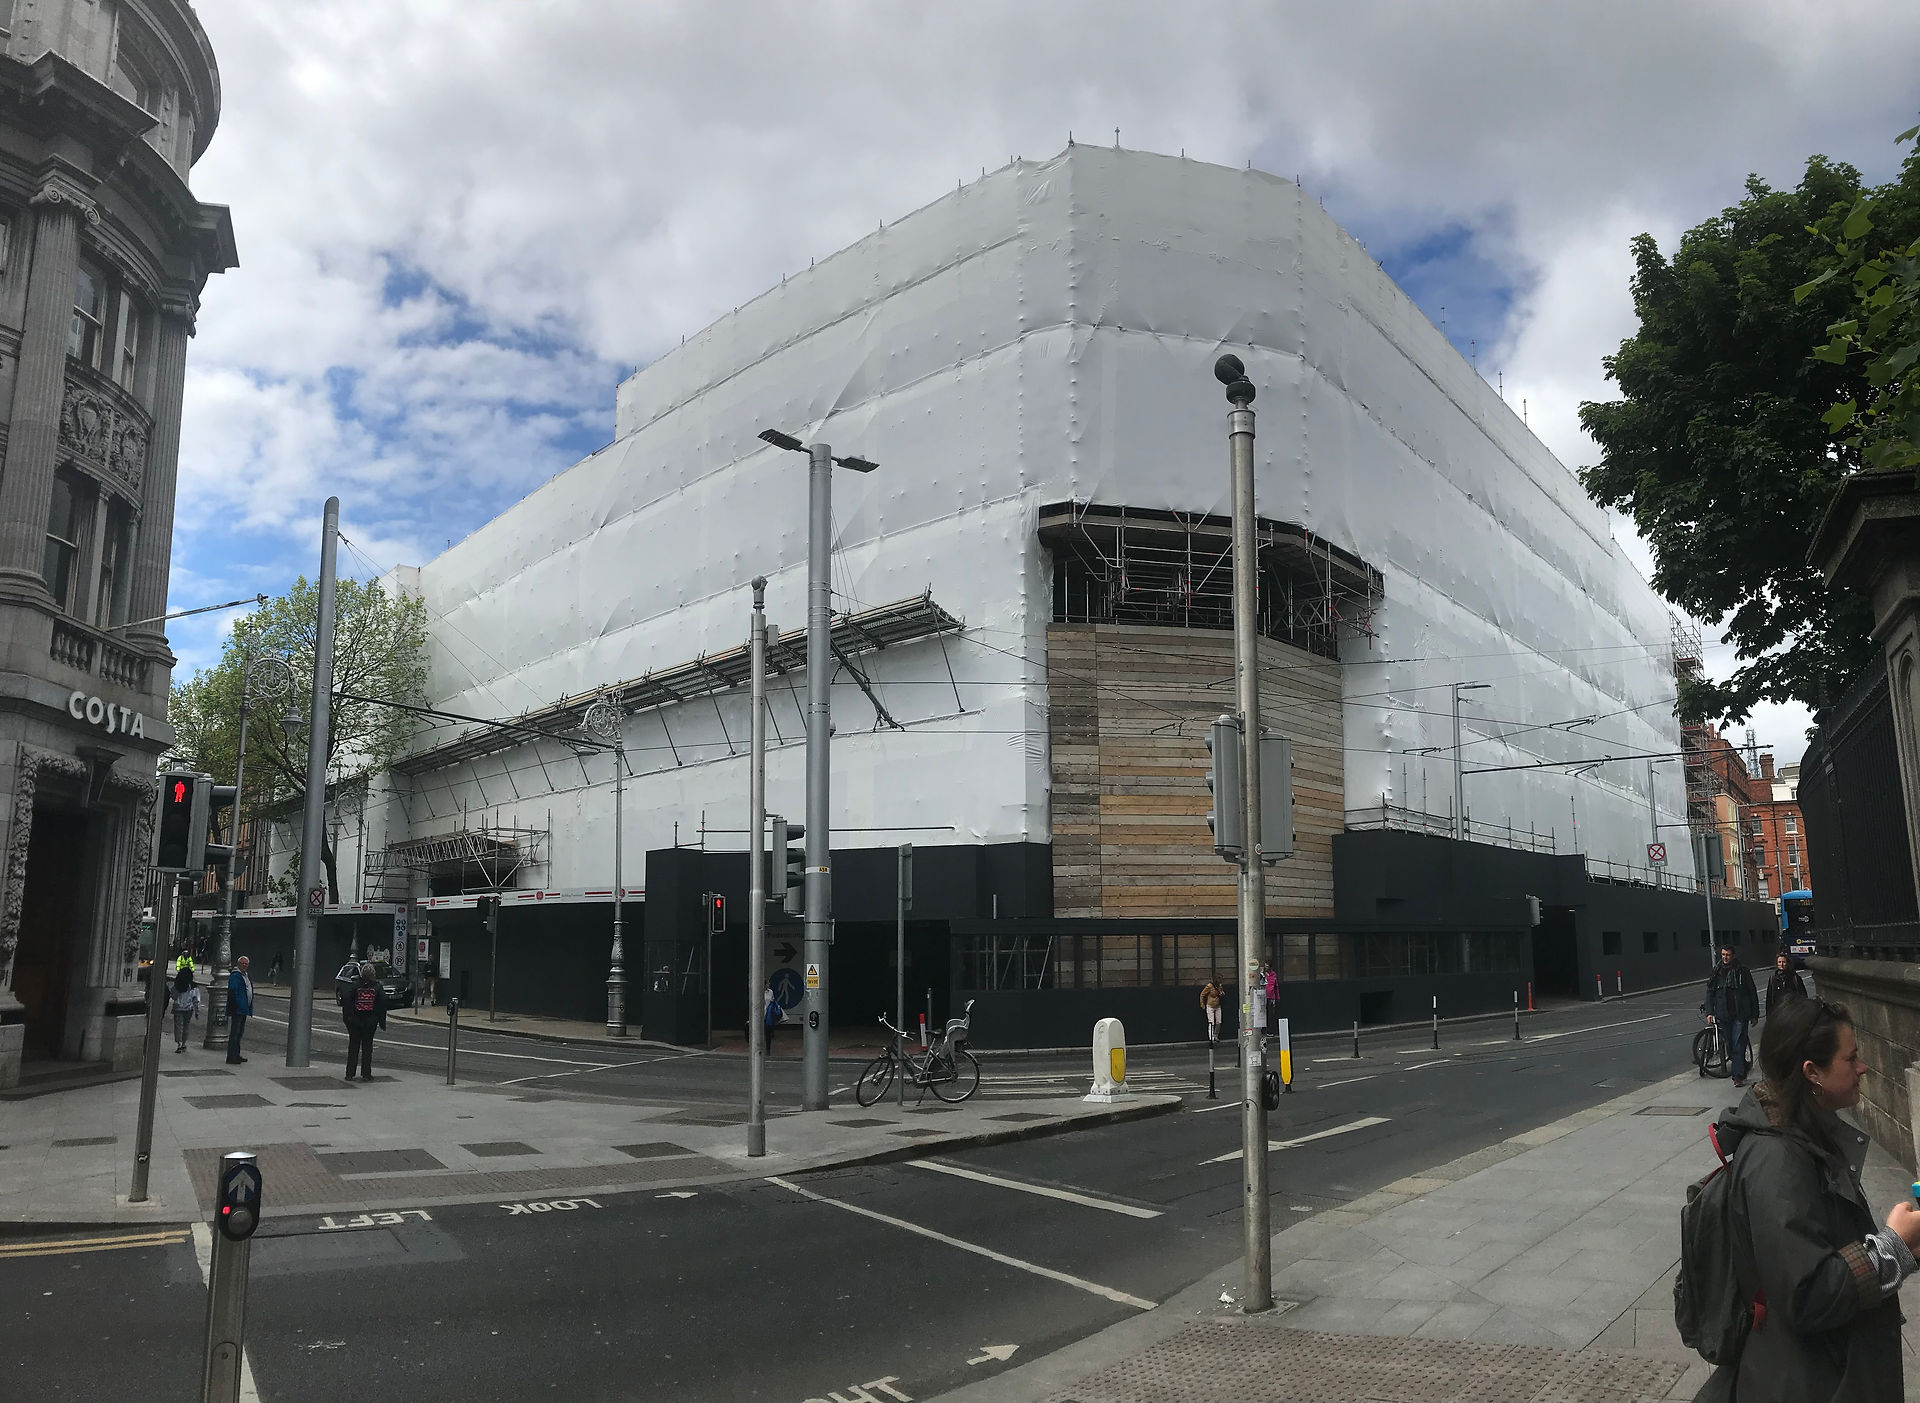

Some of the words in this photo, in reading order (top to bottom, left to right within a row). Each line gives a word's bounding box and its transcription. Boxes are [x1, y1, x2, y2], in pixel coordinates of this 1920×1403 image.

[69, 690, 144, 739] COSTA
[498, 1198, 603, 1215] LOOK
[318, 1210, 433, 1230] LEFT
[802, 1376, 915, 1403] HT
